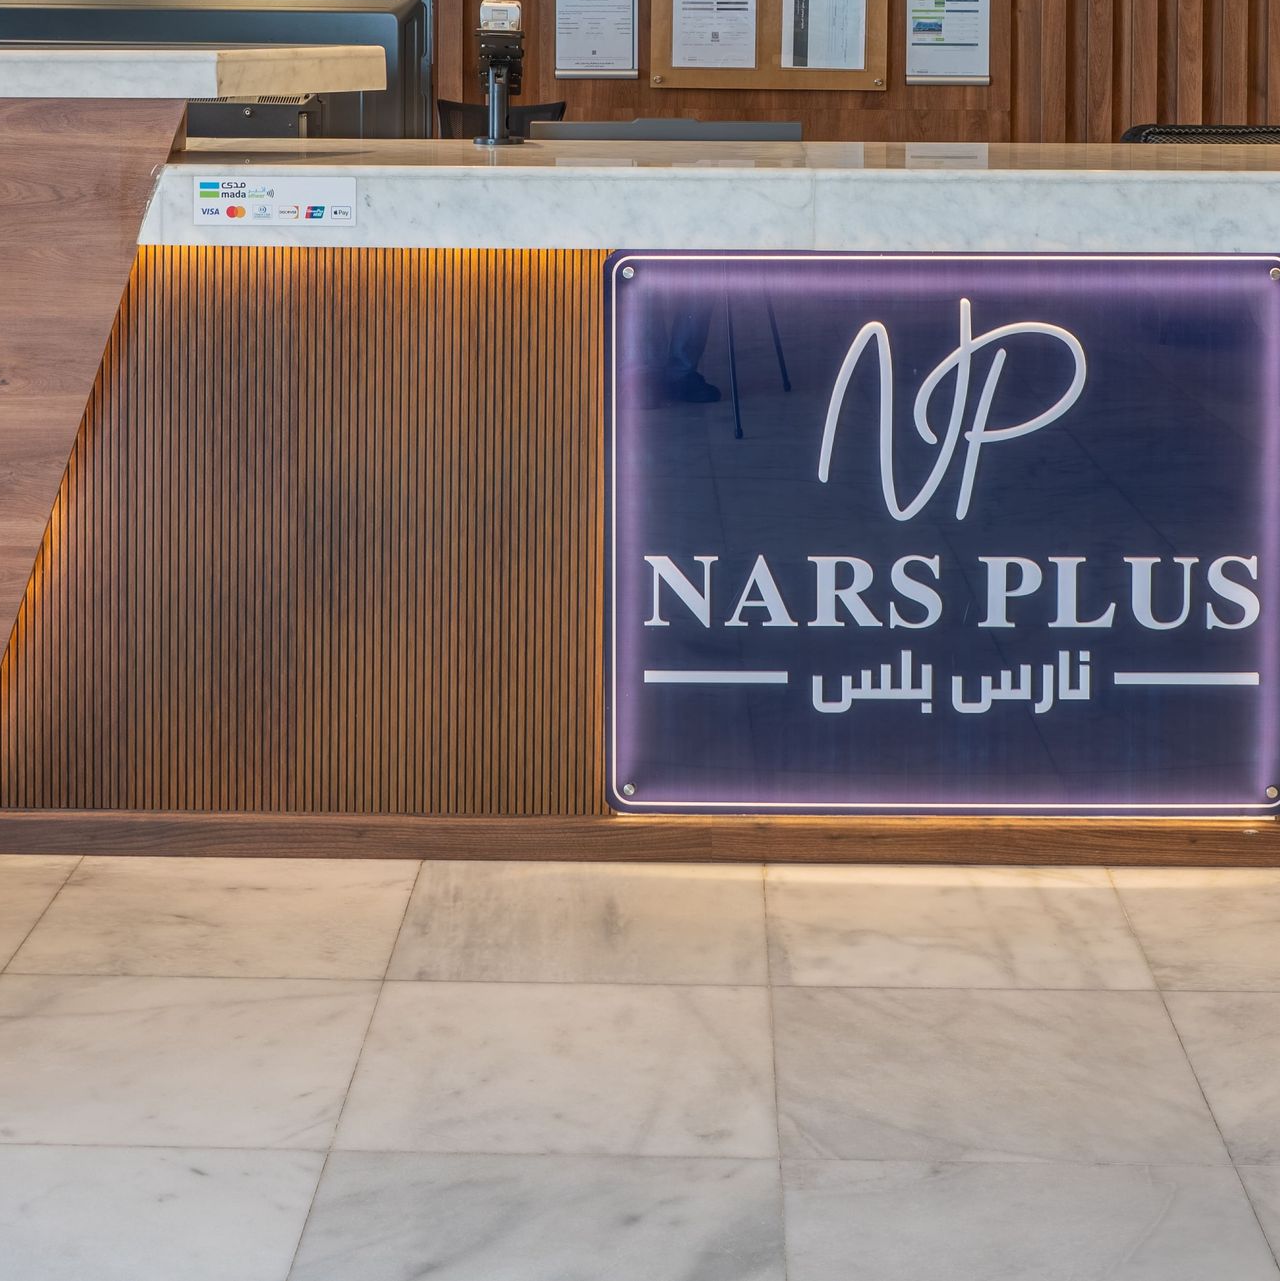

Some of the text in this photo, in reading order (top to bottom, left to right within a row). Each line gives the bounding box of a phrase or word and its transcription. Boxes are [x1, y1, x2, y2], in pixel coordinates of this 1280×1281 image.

[221, 181, 246, 189] مدى
[221, 190, 247, 199] mada
[201, 207, 220, 216] VISA
[338, 209, 349, 217] Pay
[643, 554, 1262, 630] NARS PLUS
[811, 650, 1092, 714] نارس بلس
